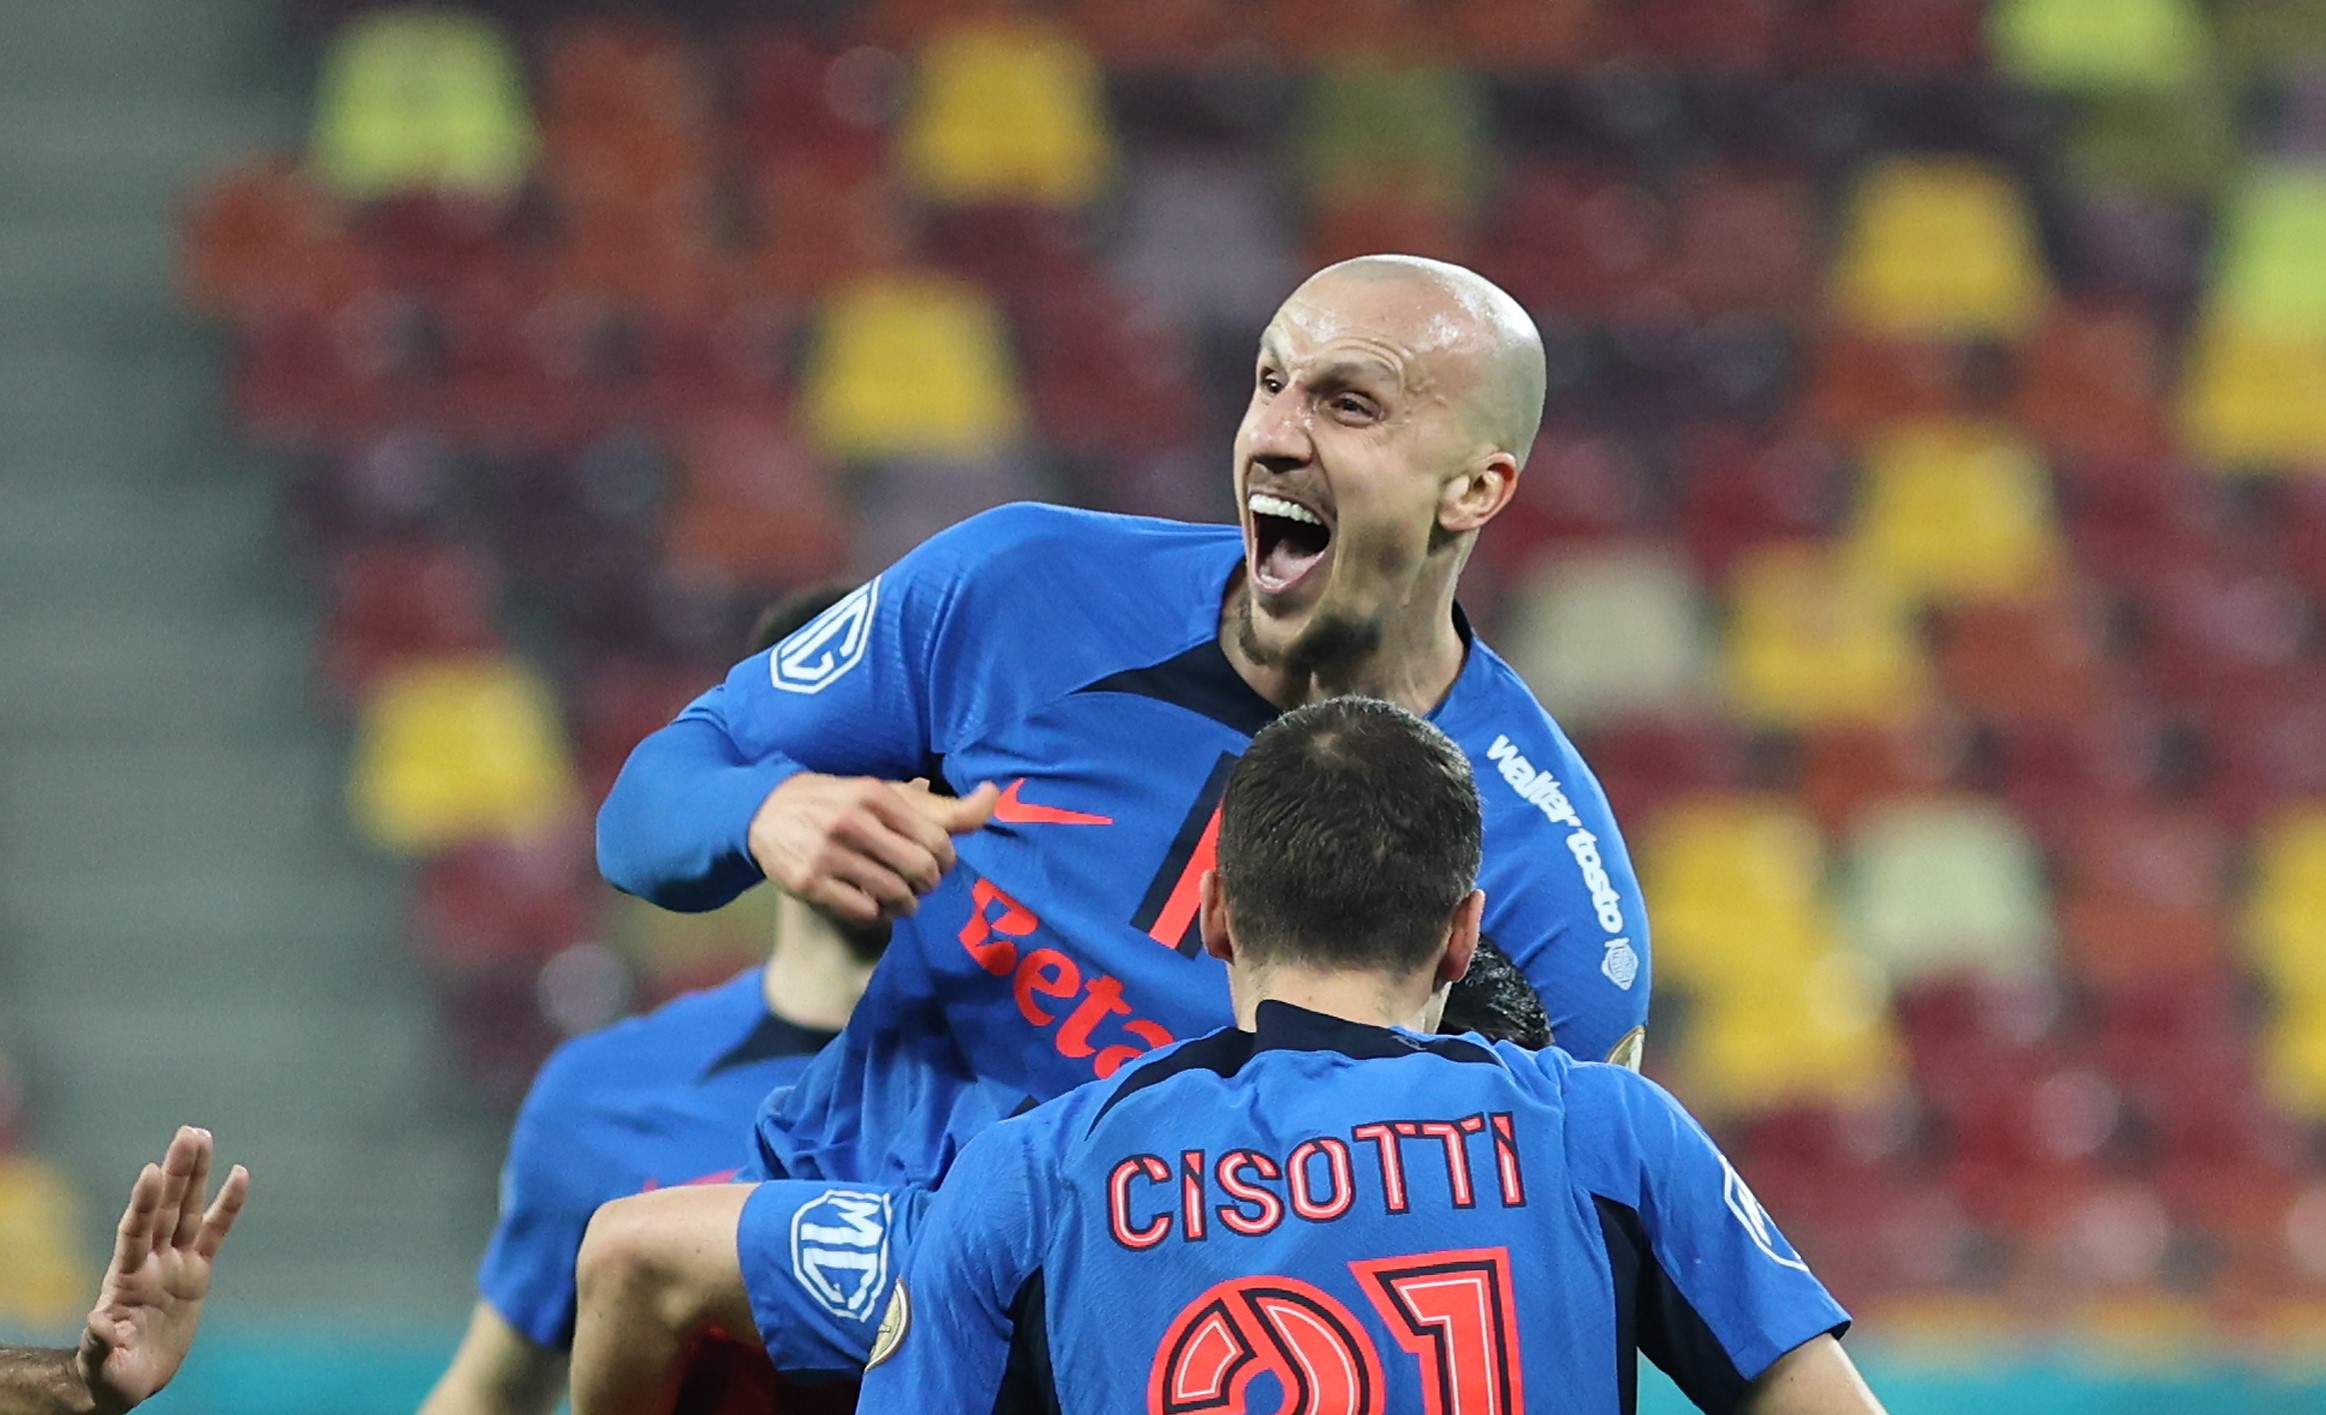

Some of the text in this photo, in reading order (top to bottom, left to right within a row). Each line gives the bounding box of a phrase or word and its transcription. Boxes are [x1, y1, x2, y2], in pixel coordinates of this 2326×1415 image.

[778, 581, 870, 681] G
[1486, 733, 1583, 827] walter
[1566, 828, 1624, 934] tosto
[1106, 1110, 1527, 1252] CISOTTI
[799, 1196, 885, 1311] MG
